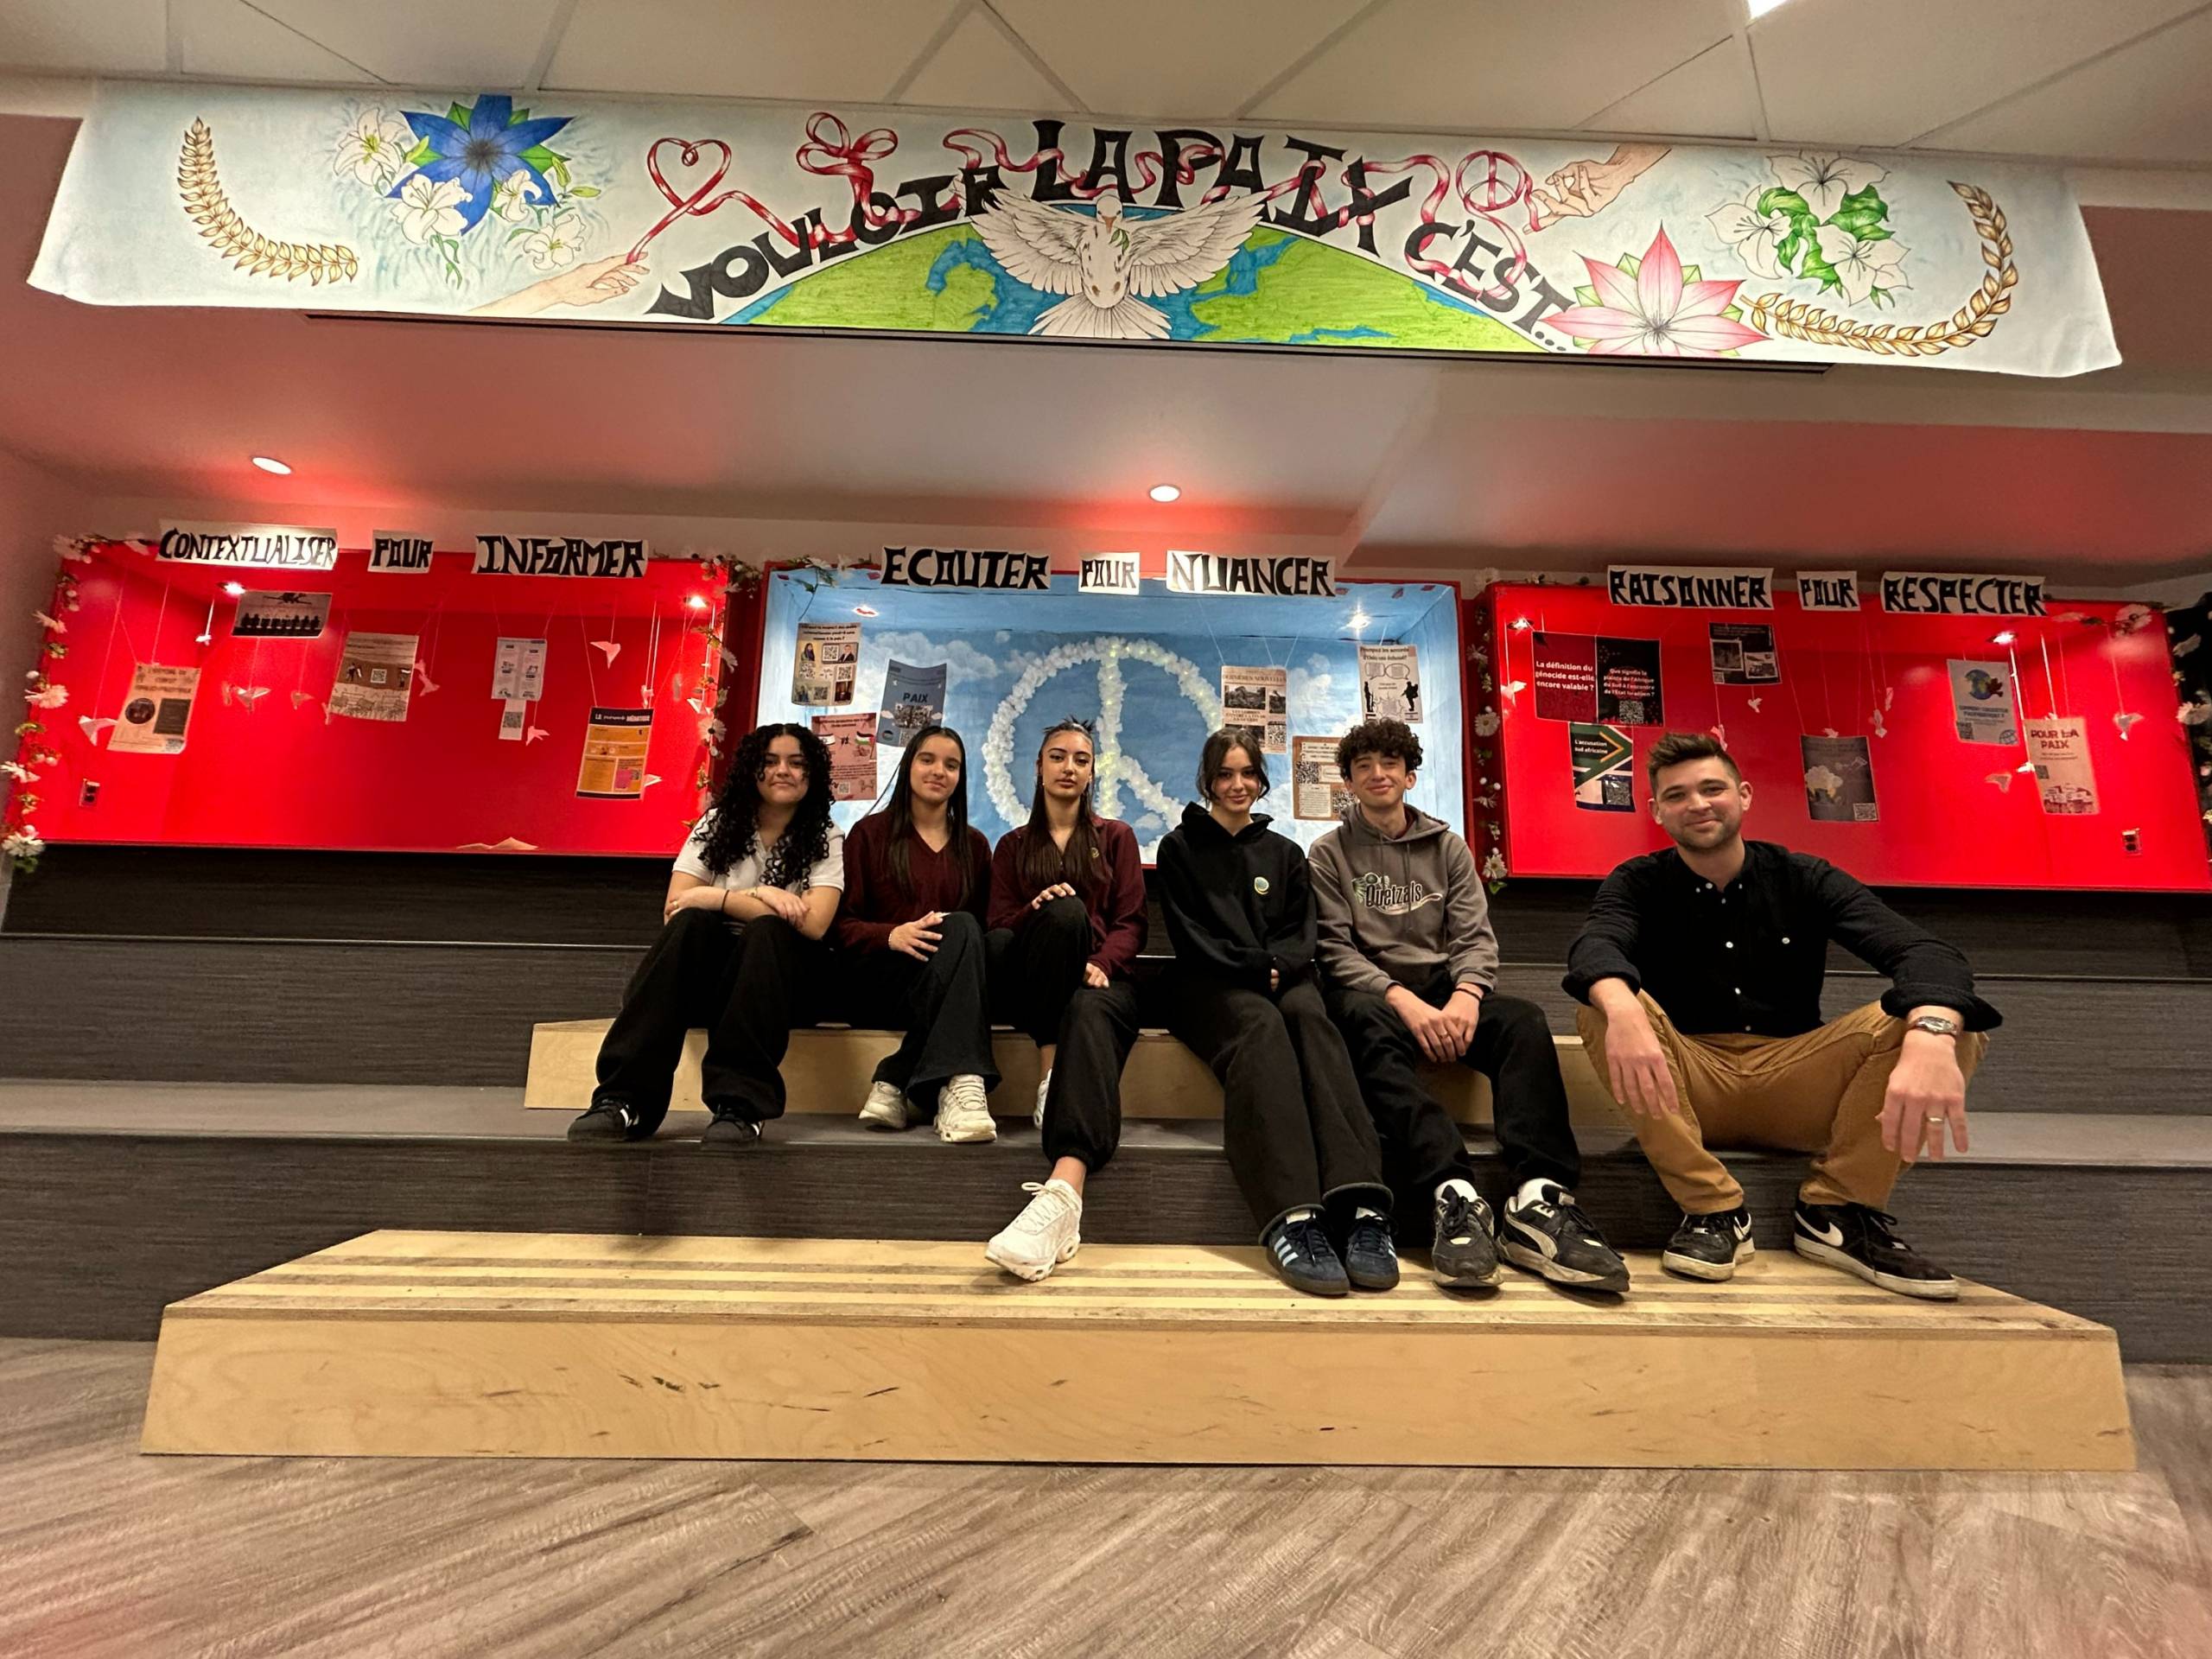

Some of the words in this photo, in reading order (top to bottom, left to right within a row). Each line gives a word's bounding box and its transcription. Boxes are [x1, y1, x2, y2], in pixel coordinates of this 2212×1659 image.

[645, 165, 1011, 321] VOULOIR
[1032, 120, 1136, 205] LA
[1154, 128, 1414, 257] PAIX
[160, 527, 337, 567] CONTEXTUALISER
[372, 537, 433, 569] POUR
[476, 535, 645, 577] INFORMER
[880, 545, 1050, 590] ECOUTER
[1081, 559, 1138, 588] POUR
[1171, 552, 1336, 596] NUANCER
[1609, 569, 1773, 608] RAISONNER
[1801, 578, 1859, 607] POUR
[1883, 576, 2047, 616] RESPECTER
[1546, 662, 1582, 671] définition
[1535, 671, 1567, 679] génocide
[1561, 683, 1589, 691] valable
[903, 692, 929, 702] PAIX
[2031, 729, 2058, 738] POUR
[2061, 729, 2080, 738] LA
[2041, 741, 2069, 749] PAIX
[1366, 880, 1423, 908] Quetzals
